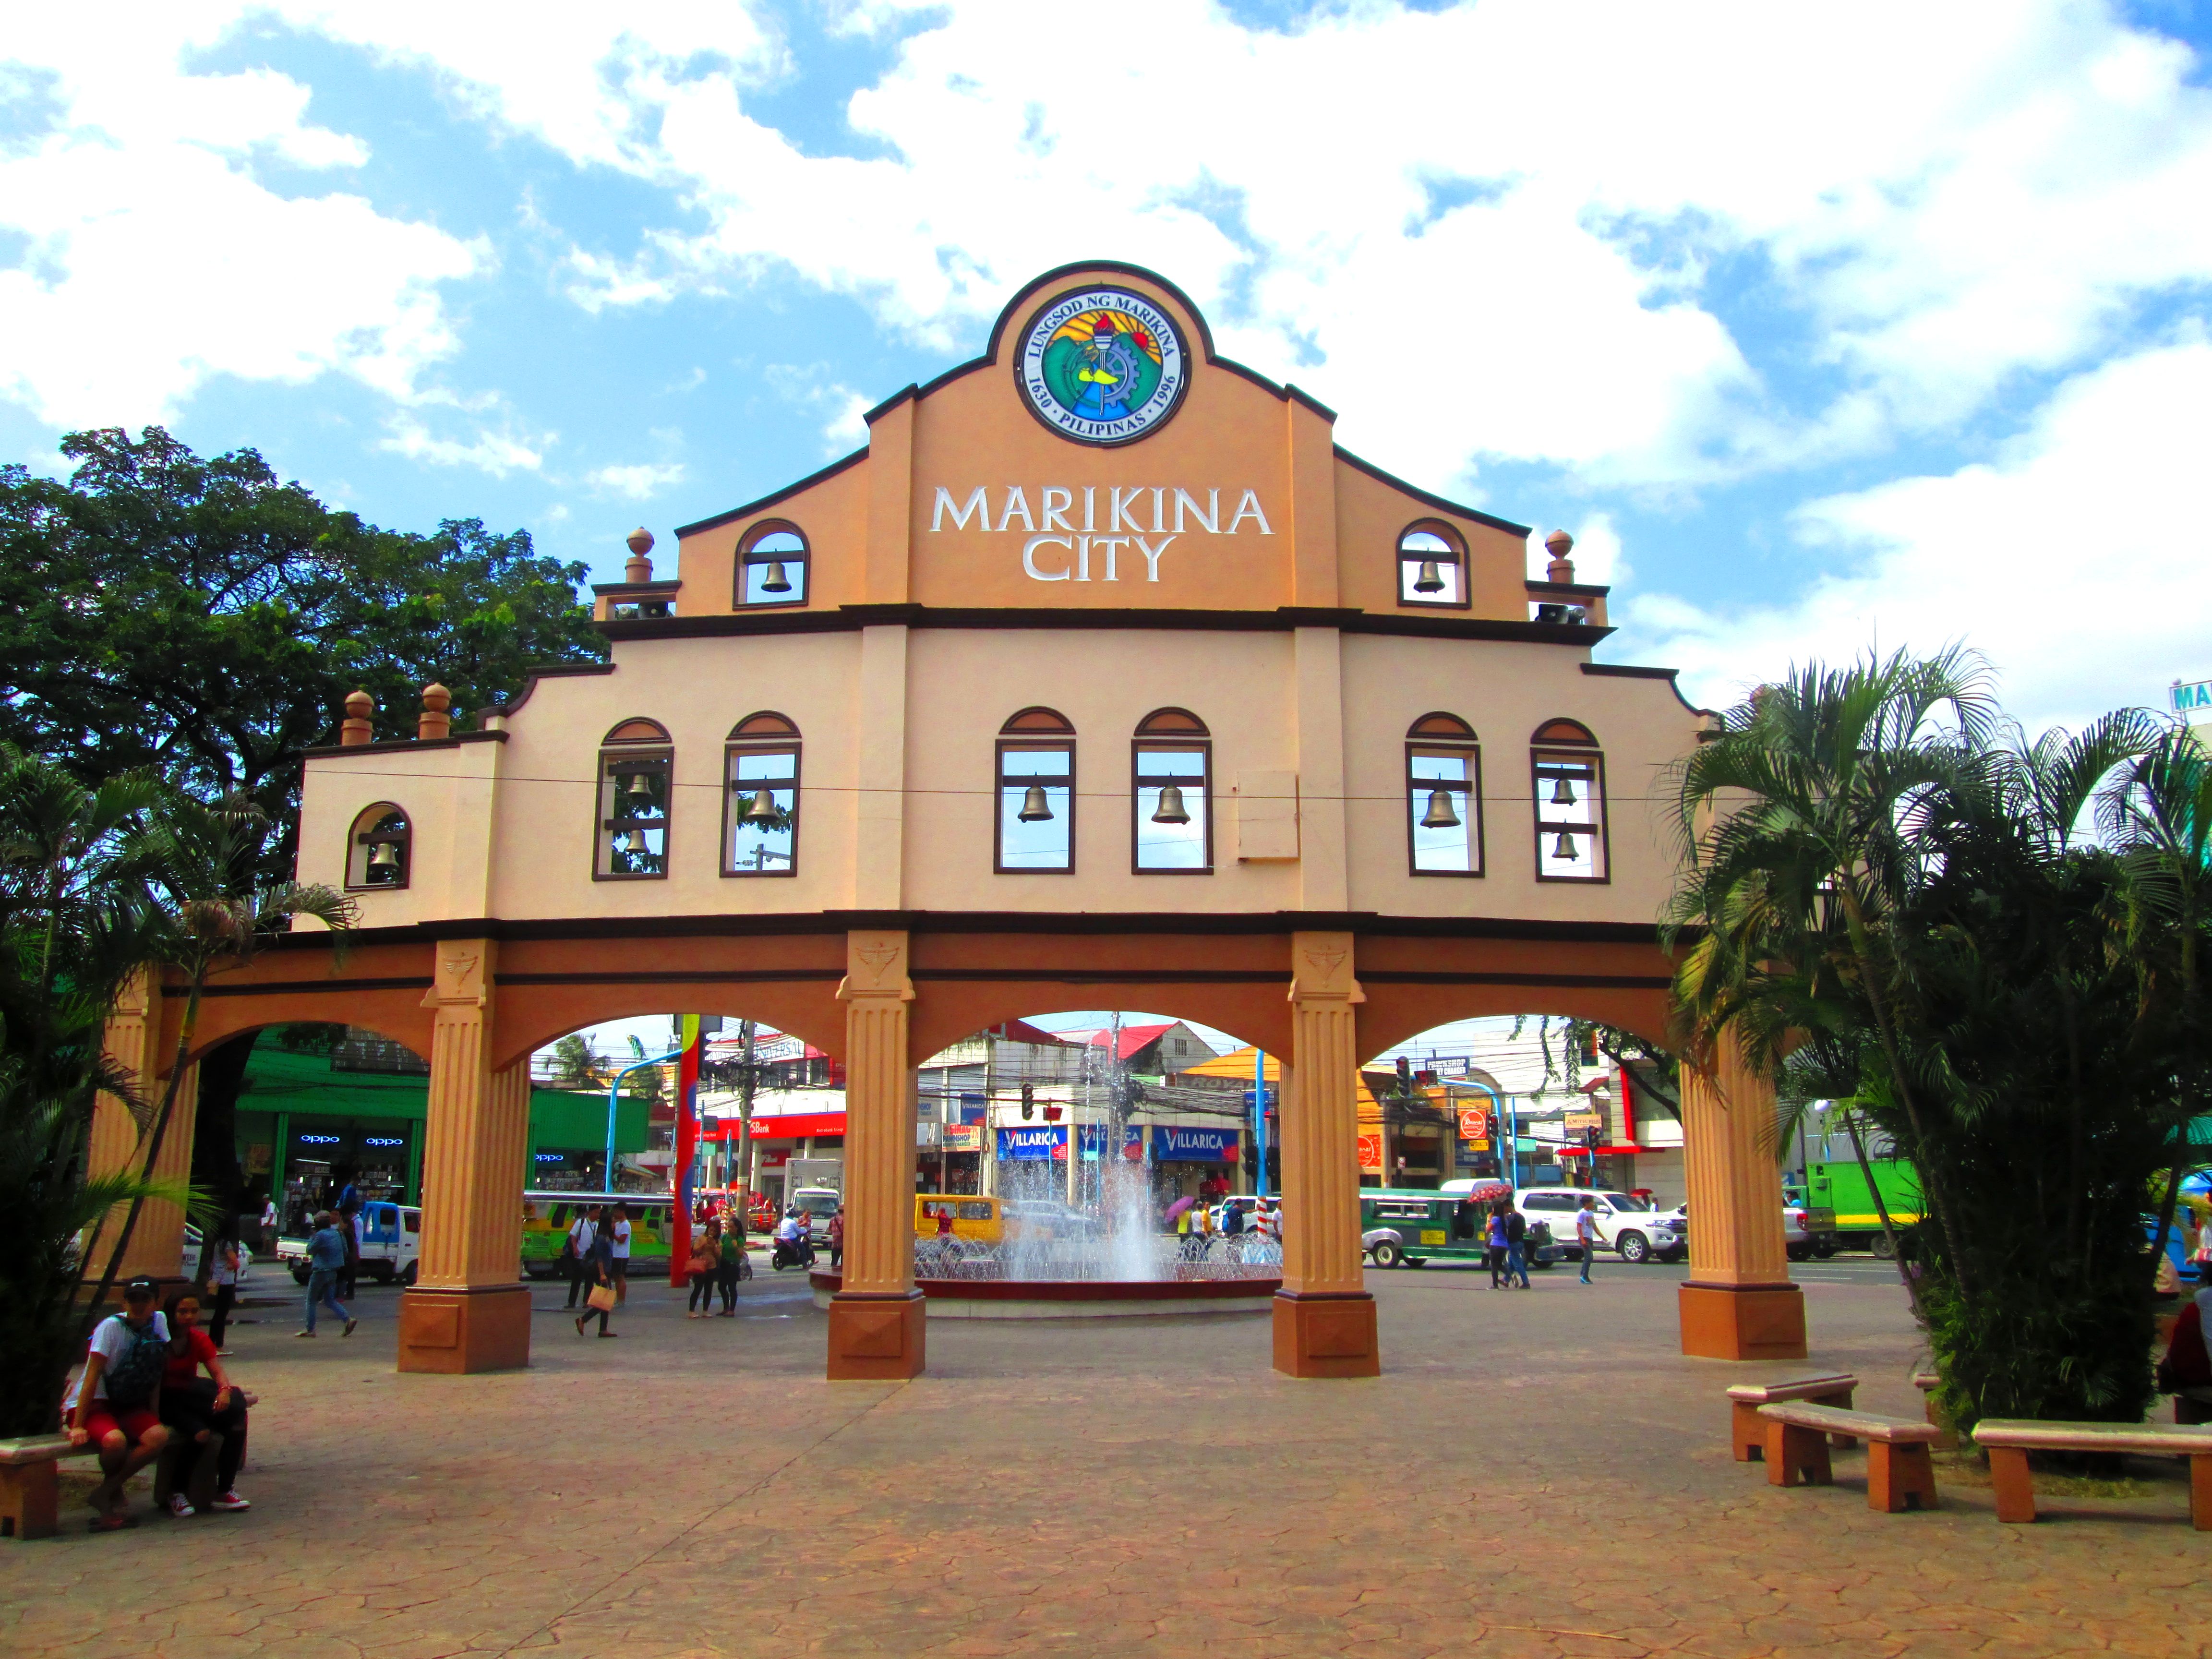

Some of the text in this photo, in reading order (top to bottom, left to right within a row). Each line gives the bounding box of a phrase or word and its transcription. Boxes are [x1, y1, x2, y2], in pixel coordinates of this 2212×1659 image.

[1028, 295, 1174, 359] LUNGSOD NG MARIKINA
[1028, 376, 1053, 409] 1630
[1153, 374, 1177, 409] 1996
[1058, 412, 1146, 435] PILIPINAS
[929, 486, 1275, 534] MARIKINA
[1023, 535, 1177, 582] CITY
[2174, 683, 2212, 709] MA
[754, 1040, 802, 1059] NIVERSAL
[750, 1121, 769, 1133] SBank
[1005, 1130, 1058, 1150] VILLARICA
[1164, 1128, 1224, 1151] VILLARICA
